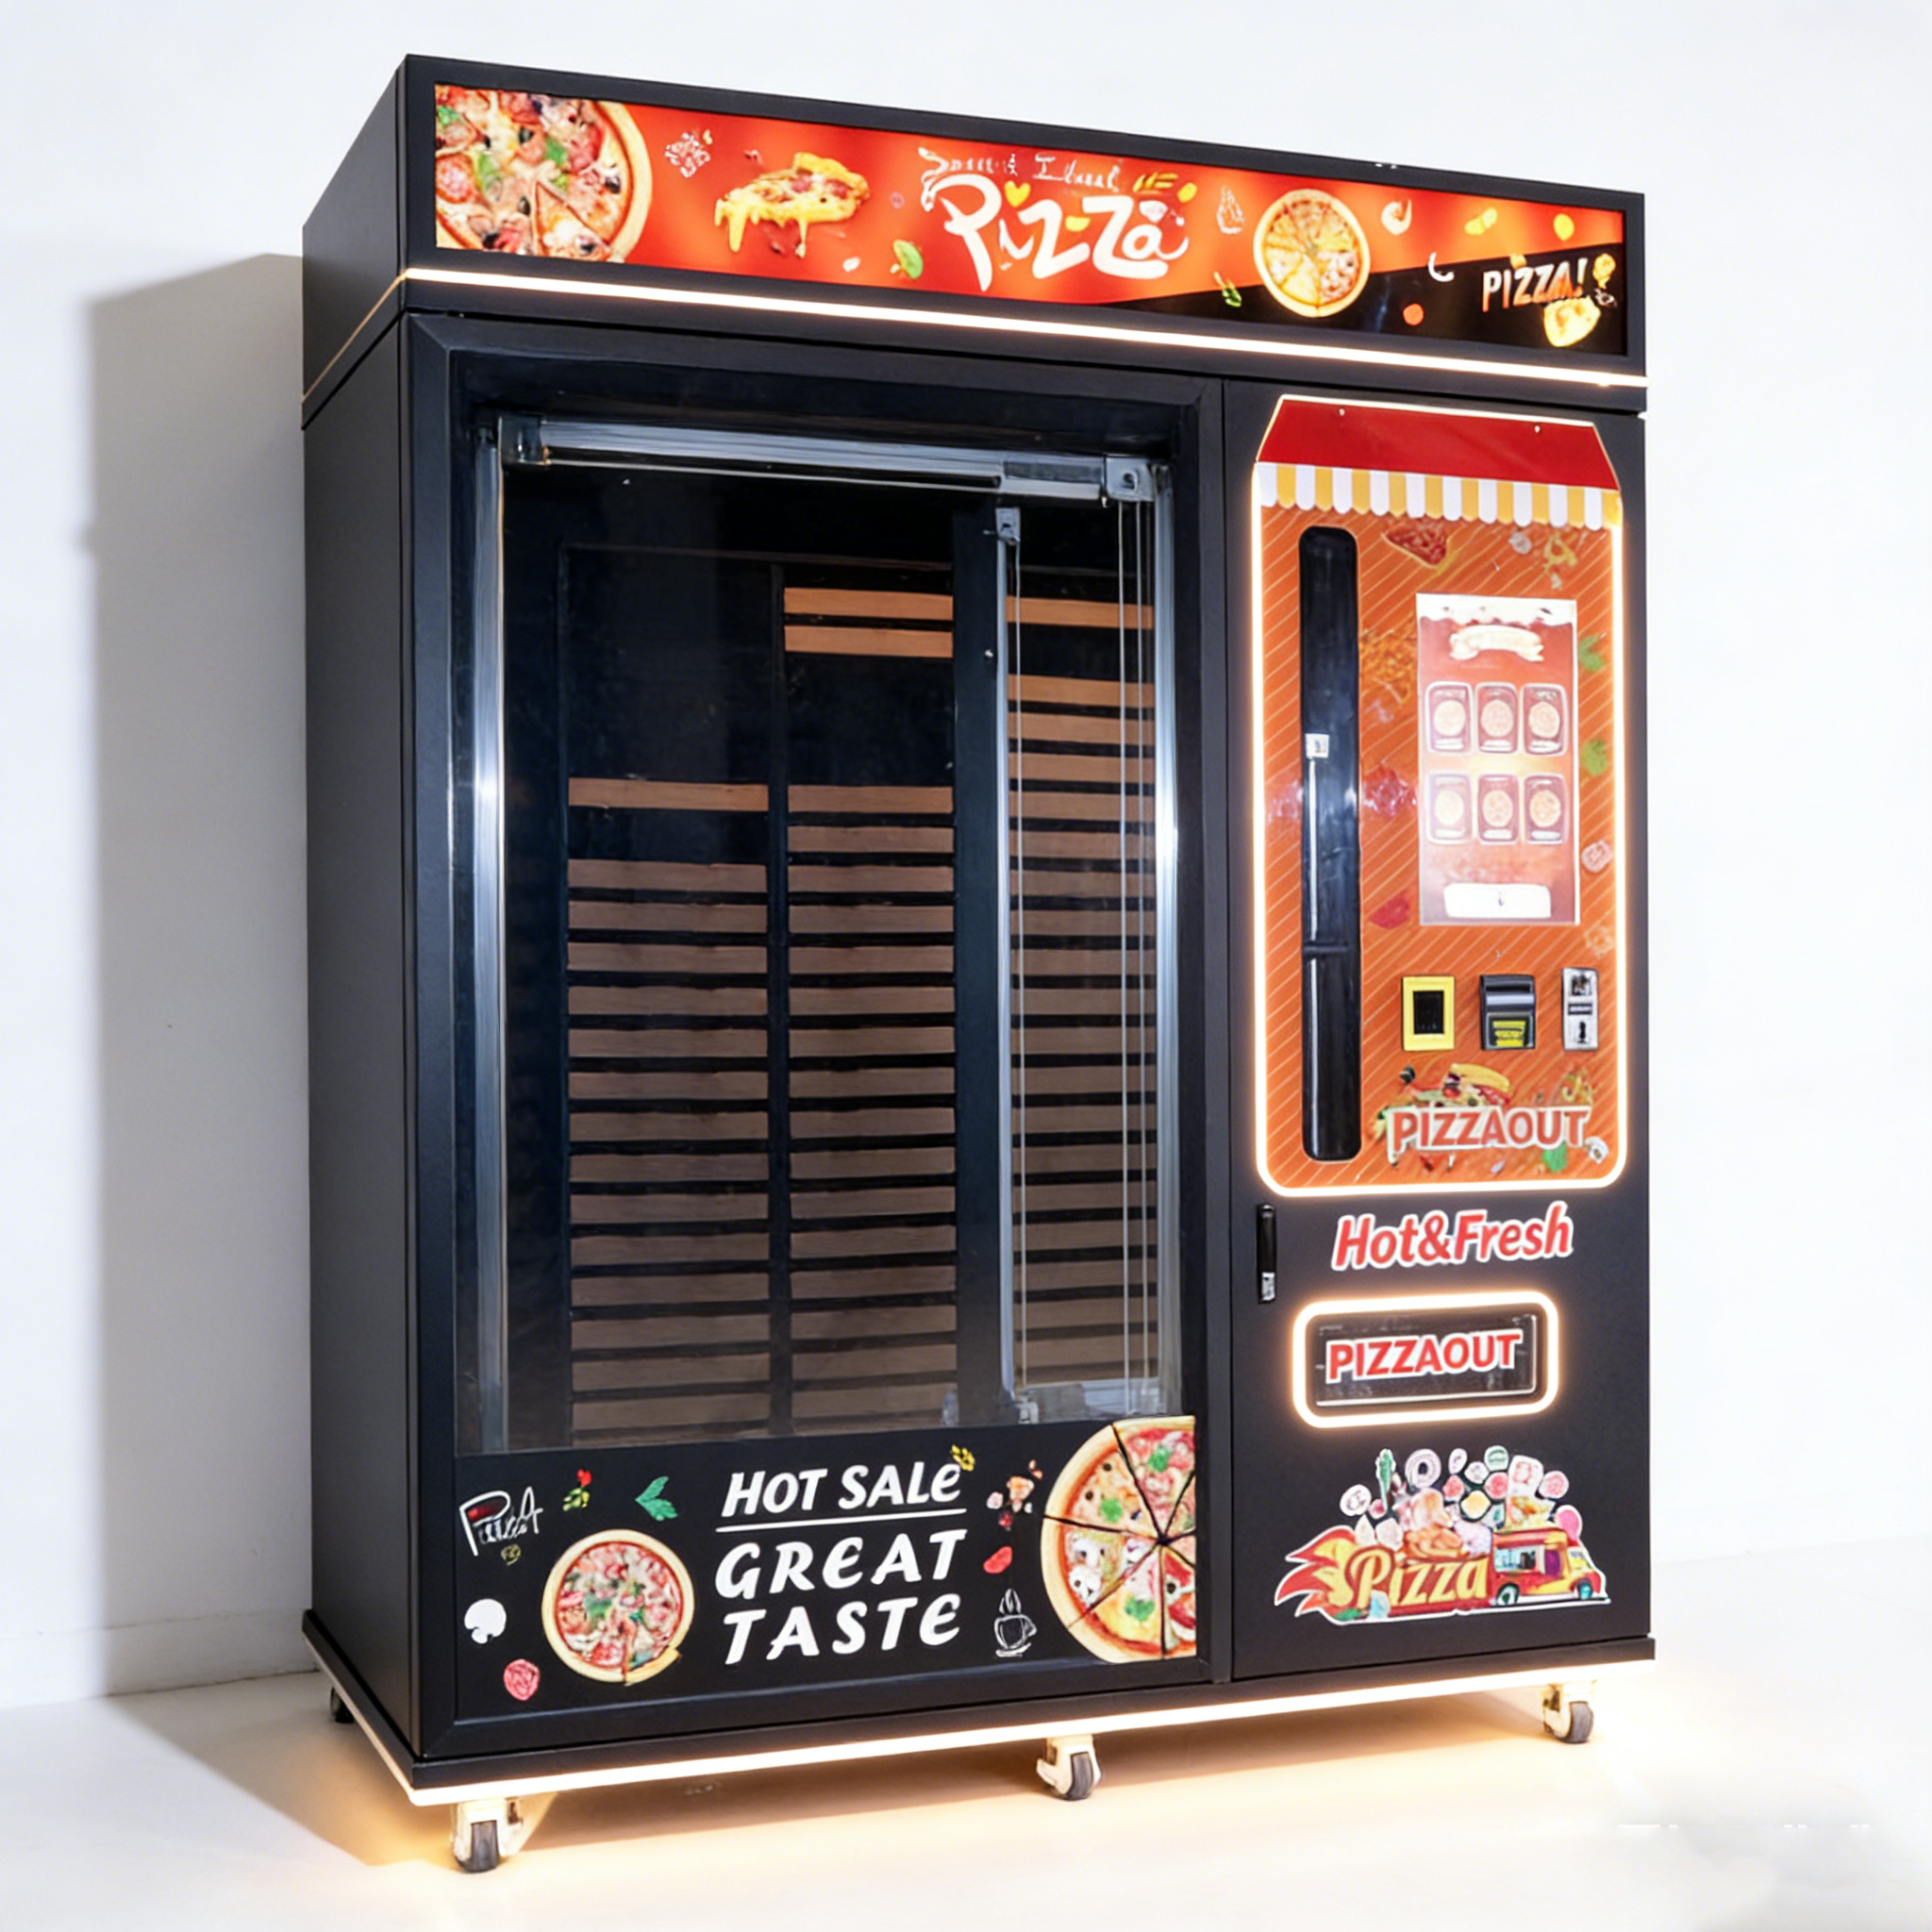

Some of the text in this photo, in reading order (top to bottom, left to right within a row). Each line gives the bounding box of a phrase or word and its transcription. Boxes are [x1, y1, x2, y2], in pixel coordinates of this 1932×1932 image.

[1482, 258, 1588, 312] PIZZA!
[1389, 1106, 1591, 1157] PIZZAOUT
[1332, 1202, 1573, 1270] Hot&Fresh
[1326, 1331, 1523, 1383] PIZZAOUT
[721, 1461, 961, 1517] HOT SALE
[715, 1529, 968, 1600] GREAT
[1350, 1549, 1490, 1609] Pizza
[724, 1593, 961, 1665] TASTE
